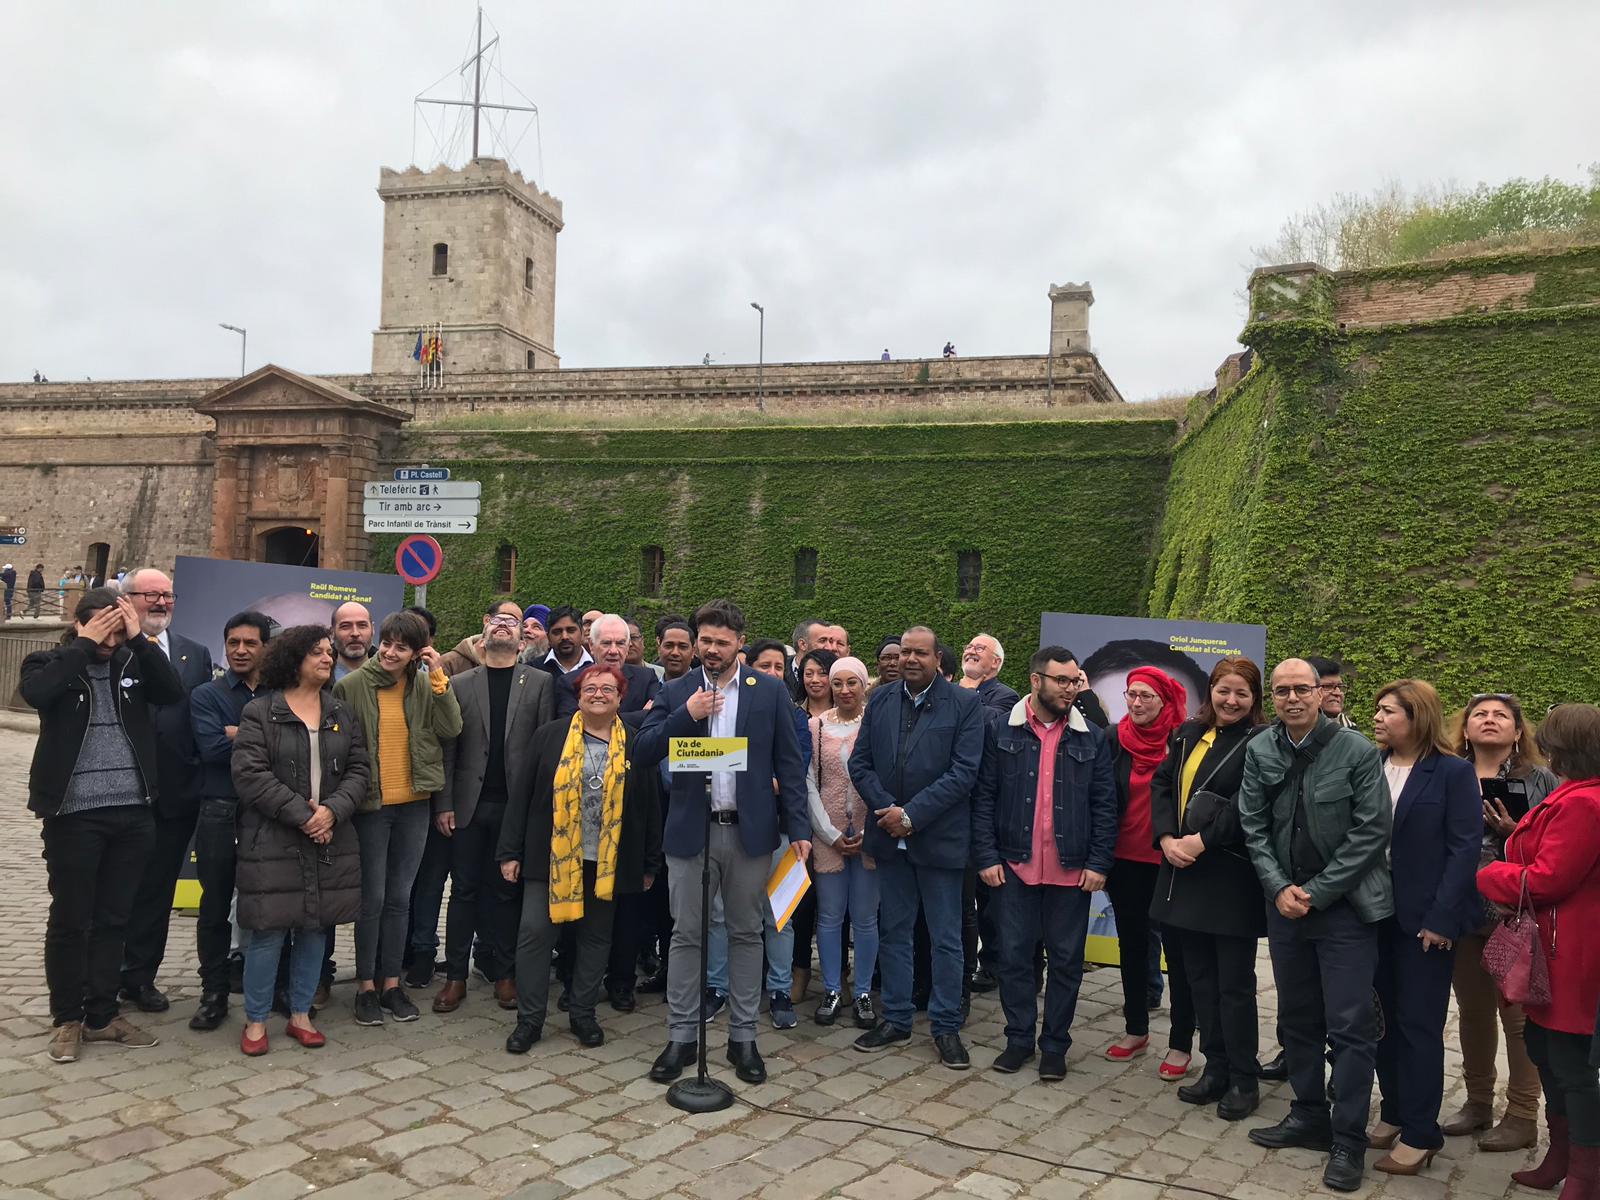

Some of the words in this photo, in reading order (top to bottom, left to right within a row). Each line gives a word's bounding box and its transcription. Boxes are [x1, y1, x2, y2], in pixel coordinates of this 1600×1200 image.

[380, 484, 417, 494] Telefèric
[379, 501, 391, 511] Tir
[394, 502, 413, 511] amb
[416, 503, 431, 511] arc
[368, 520, 385, 528] Parc
[387, 519, 413, 528] Infantil
[414, 520, 424, 528] de
[426, 520, 451, 528] Trànsit
[328, 584, 357, 593] Romeva
[309, 591, 342, 600] Candidat
[351, 595, 372, 603] Senat
[1169, 635, 1188, 643] Oriol
[1189, 636, 1227, 646] Junqueras
[1169, 644, 1202, 653] Candidat
[1204, 646, 1210, 654] al
[1212, 647, 1242, 656] Congrés
[677, 740, 689, 748] Va
[690, 740, 702, 748] de
[676, 748, 724, 757] Ciutadania
